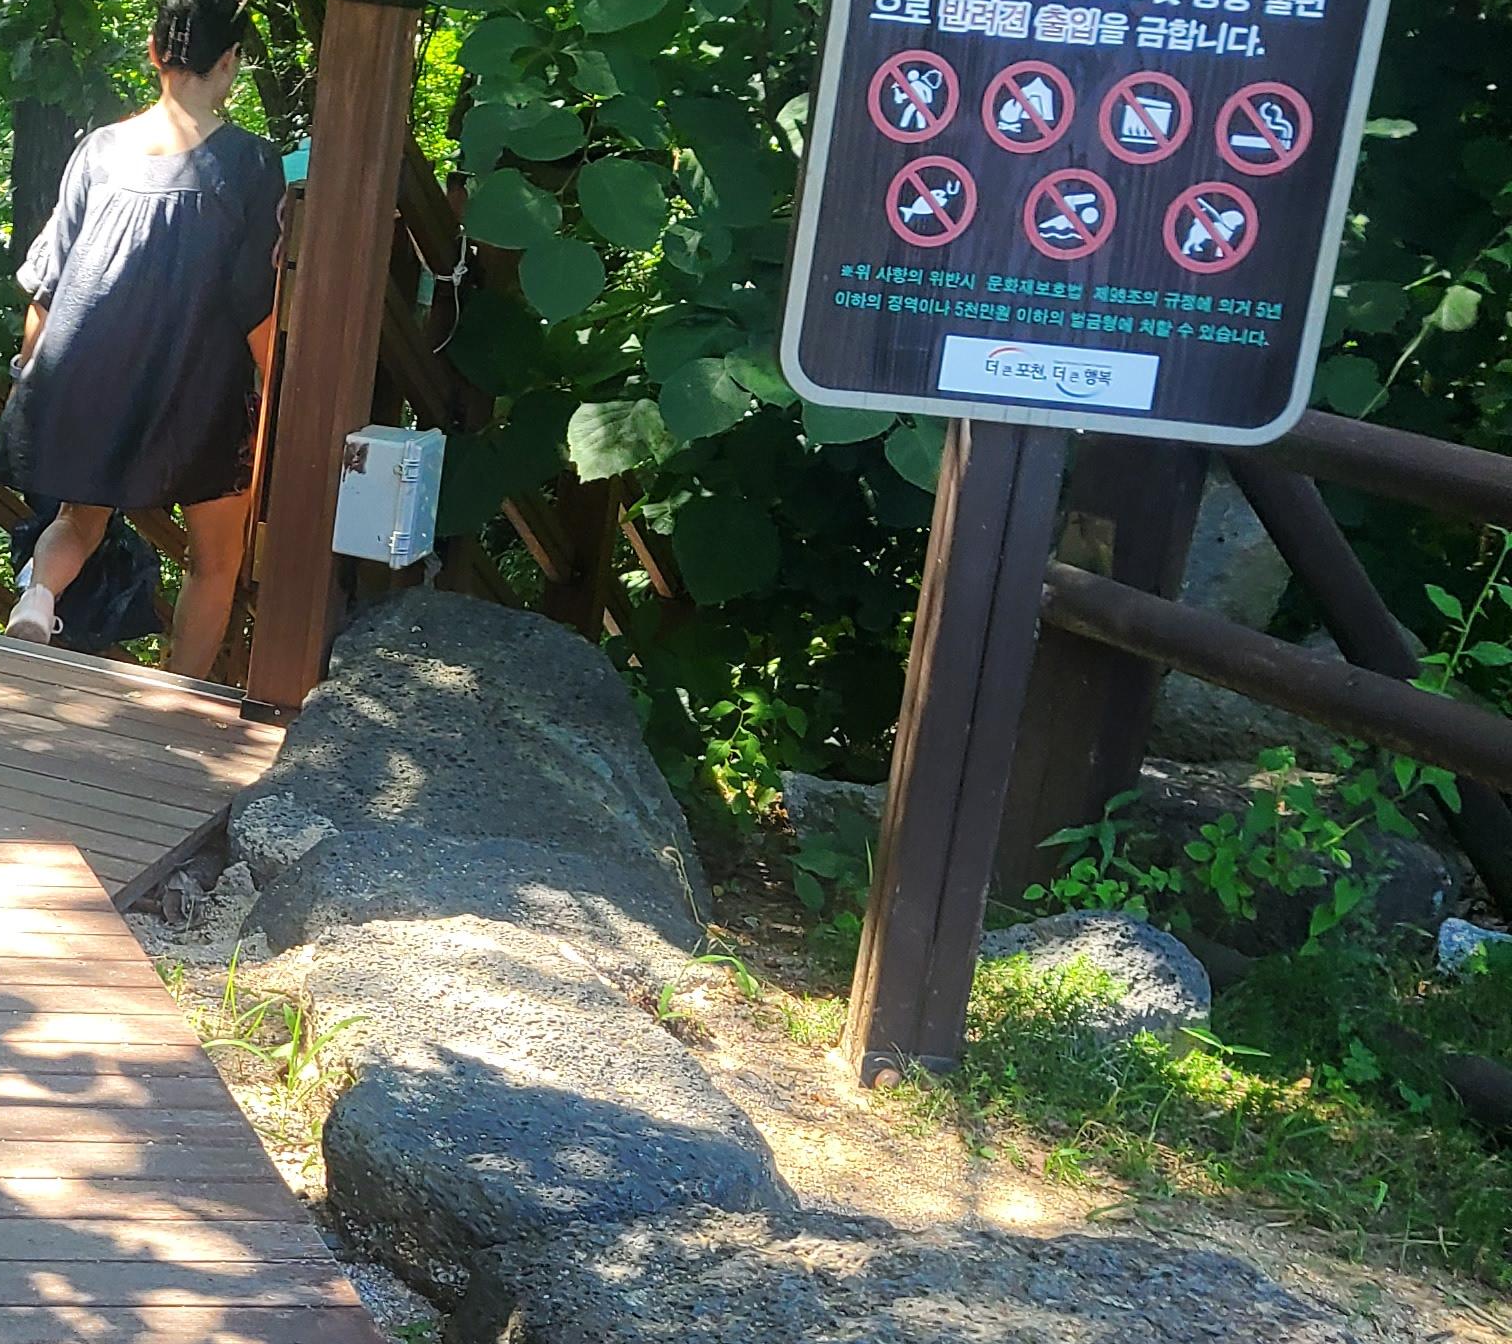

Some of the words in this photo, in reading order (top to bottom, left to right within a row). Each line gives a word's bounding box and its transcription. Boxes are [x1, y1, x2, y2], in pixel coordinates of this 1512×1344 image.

[1035, 5, 1129, 44] 출입을
[1137, 16, 1265, 56] 금합니다.
[835, 291, 882, 309] 이하의
[888, 295, 949, 316] 징역이나
[955, 301, 1011, 322] 5천만원
[1017, 307, 1064, 326] 이하의
[1177, 322, 1194, 338] 수
[1199, 324, 1270, 347] 있습니다.
[876, 266, 922, 285] 사항의
[929, 271, 975, 289] 위반시
[987, 275, 1081, 302] 문화재보호법
[1164, 292, 1212, 312] 규정에
[1217, 298, 1251, 316] 의거
[1256, 303, 1282, 320] 5년
[985, 360, 998, 375] 더
[1015, 363, 1047, 380] 포천,
[1053, 366, 1066, 381] 더
[1084, 369, 1112, 385] 행복
